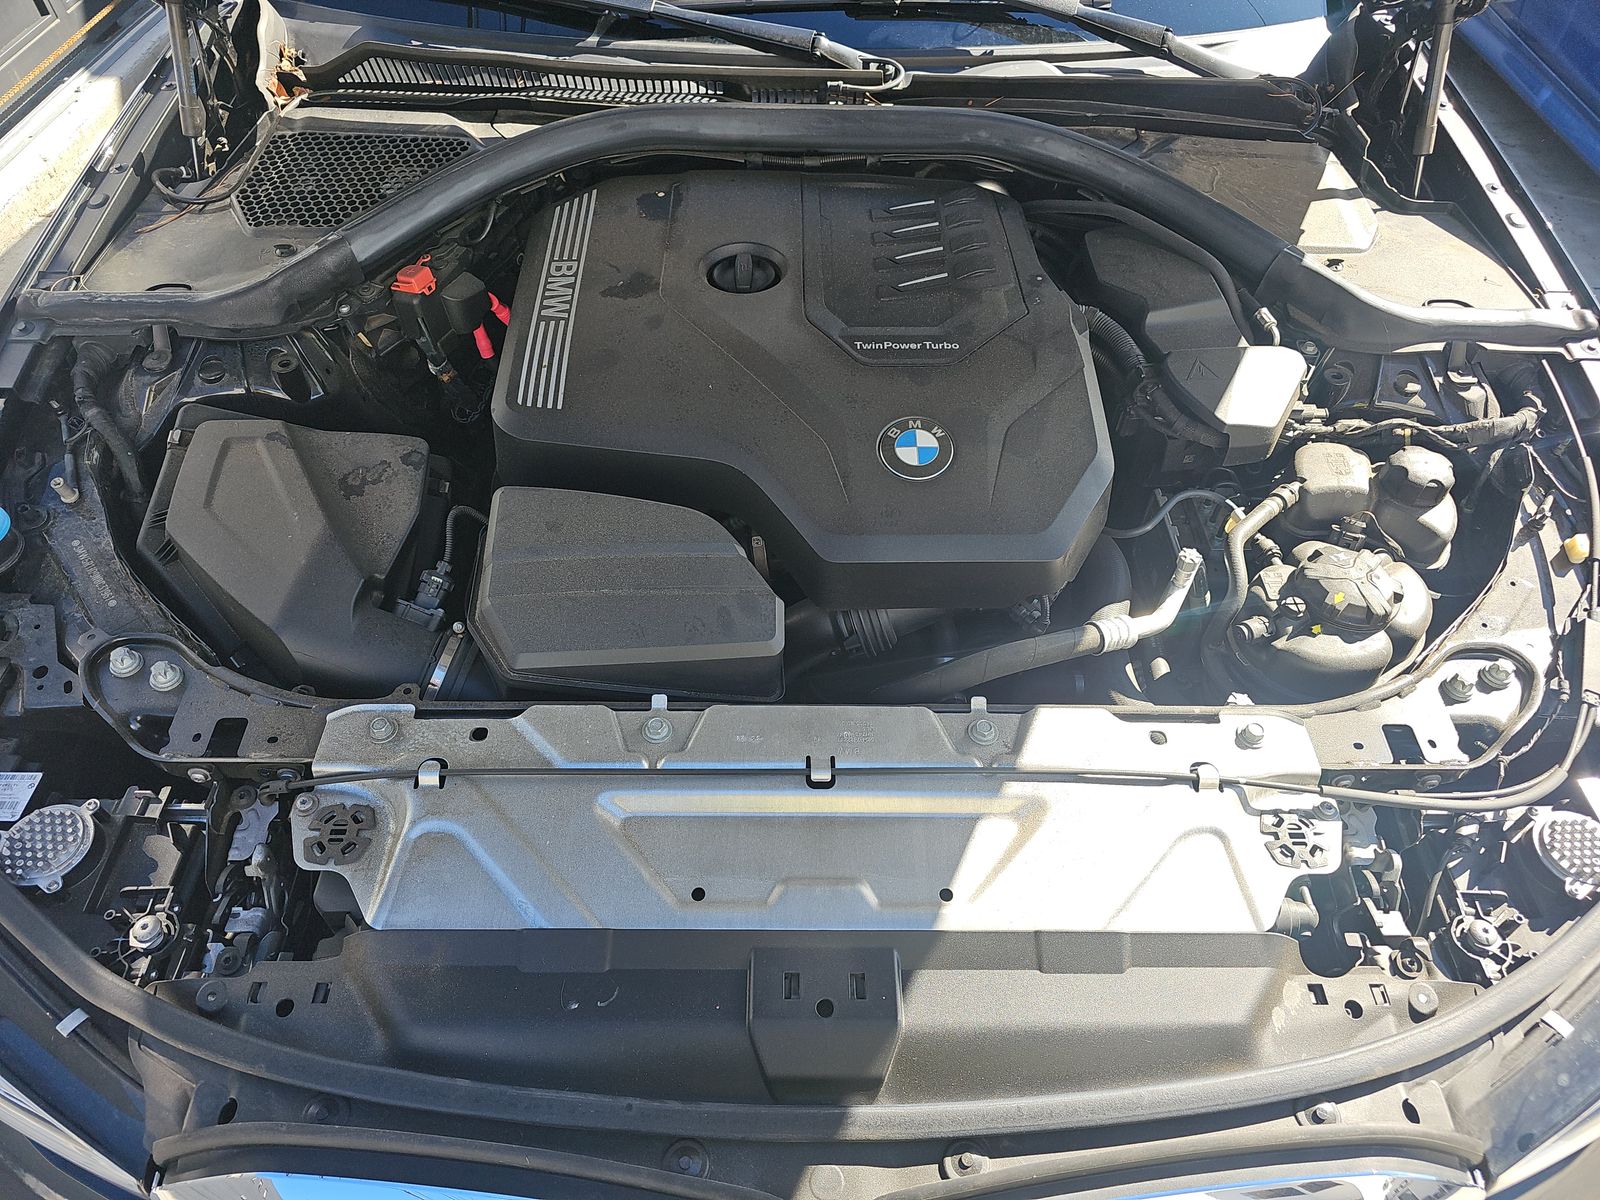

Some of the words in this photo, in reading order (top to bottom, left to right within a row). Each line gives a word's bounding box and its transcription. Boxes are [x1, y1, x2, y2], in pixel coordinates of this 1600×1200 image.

[540, 261, 578, 318] BMW
[923, 341, 960, 350] Turbo
[887, 420, 946, 439] BMW
